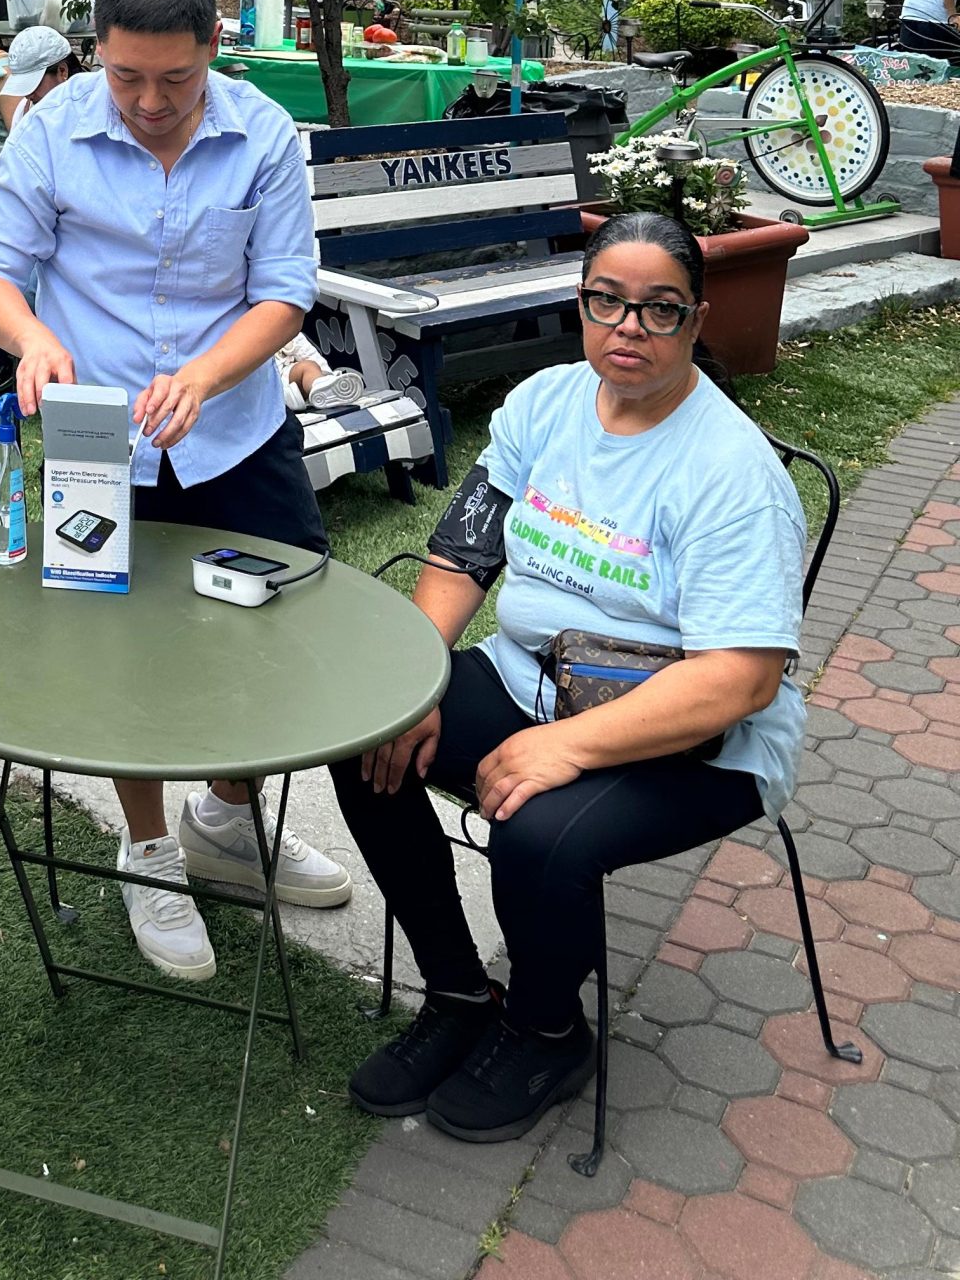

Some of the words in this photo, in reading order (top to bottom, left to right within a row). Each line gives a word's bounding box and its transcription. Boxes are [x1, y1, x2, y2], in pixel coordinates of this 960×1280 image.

[380, 148, 512, 187] YANKEES
[600, 516, 618, 530] 2025
[510, 516, 551, 550] EADING
[551, 540, 571, 560] ON
[569, 545, 597, 572] THE
[598, 559, 651, 591] RAILS
[565, 575, 594, 597] Read!
